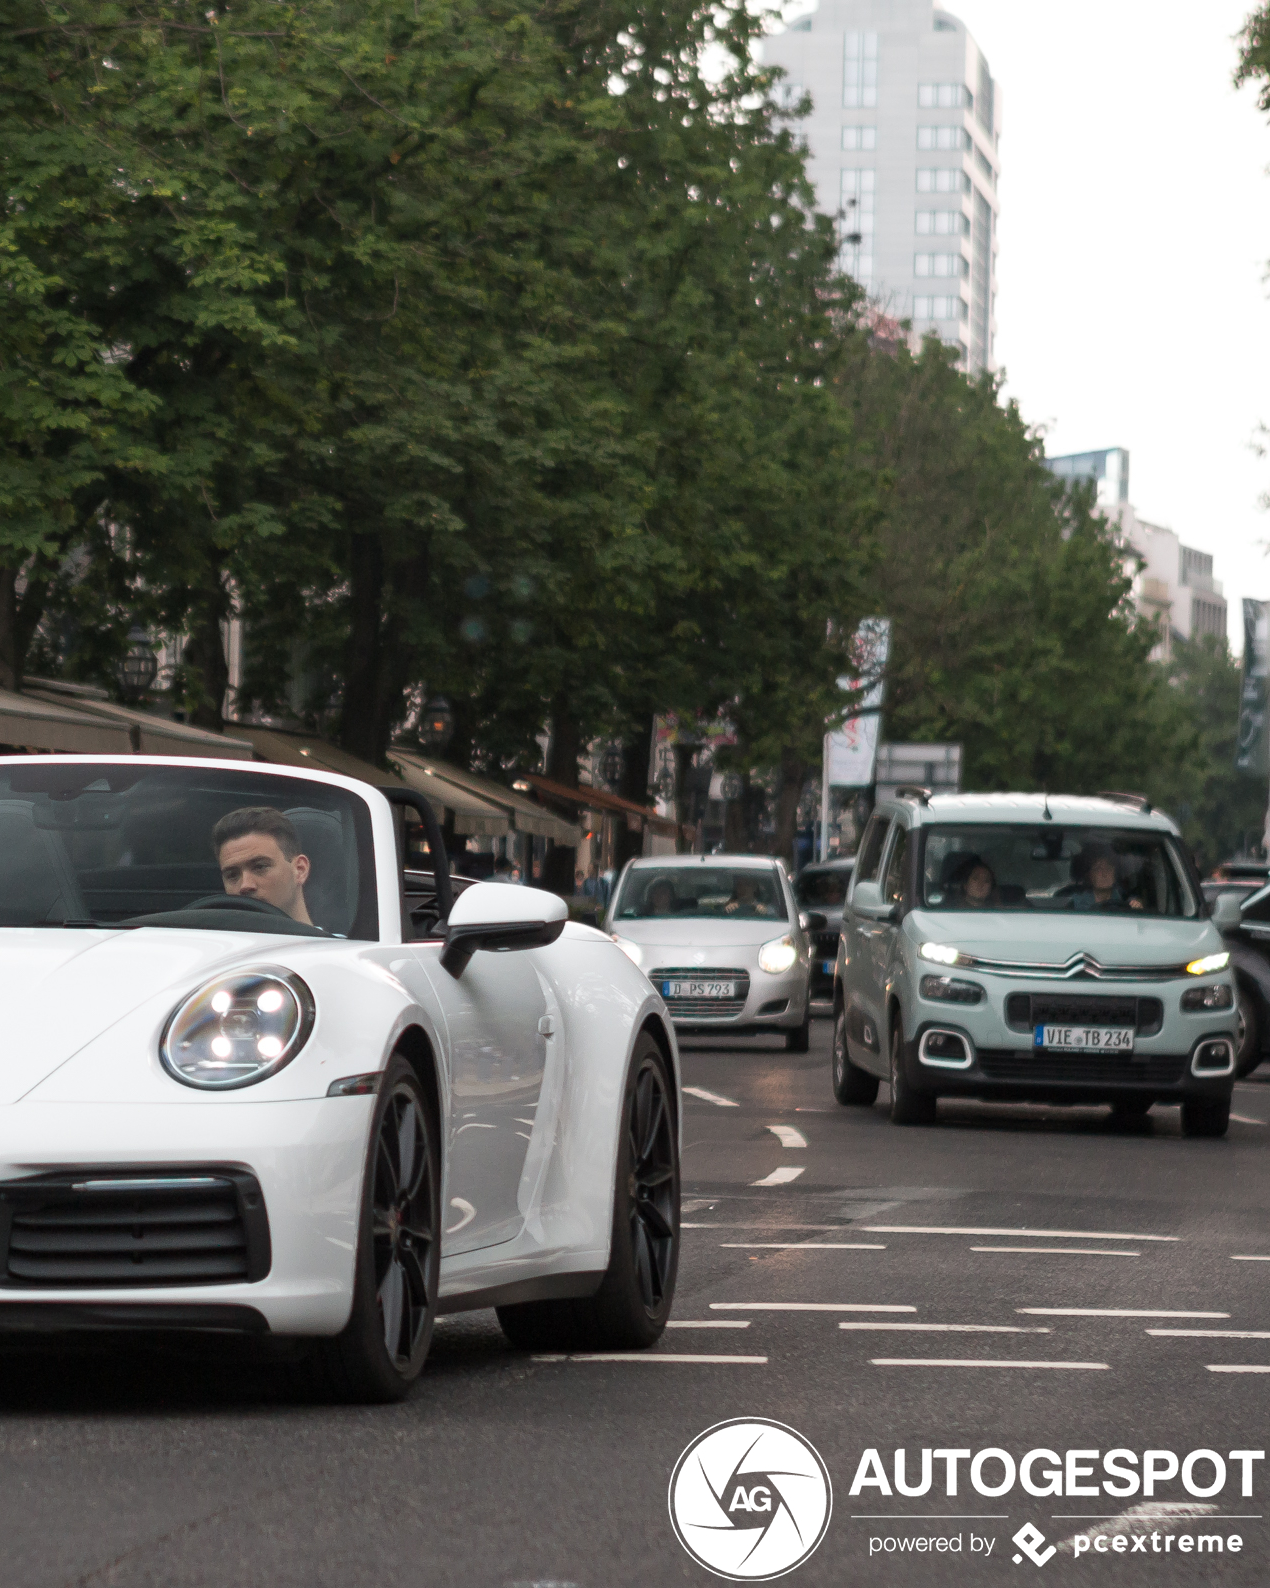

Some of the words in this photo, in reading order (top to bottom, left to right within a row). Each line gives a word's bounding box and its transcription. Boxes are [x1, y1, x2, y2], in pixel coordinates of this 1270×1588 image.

[674, 984, 681, 995] D
[690, 984, 704, 995] PS
[707, 983, 730, 995] 793
[1047, 1029, 1072, 1045] VIE
[1083, 1030, 1101, 1046] TB
[1104, 1031, 1131, 1047] 234
